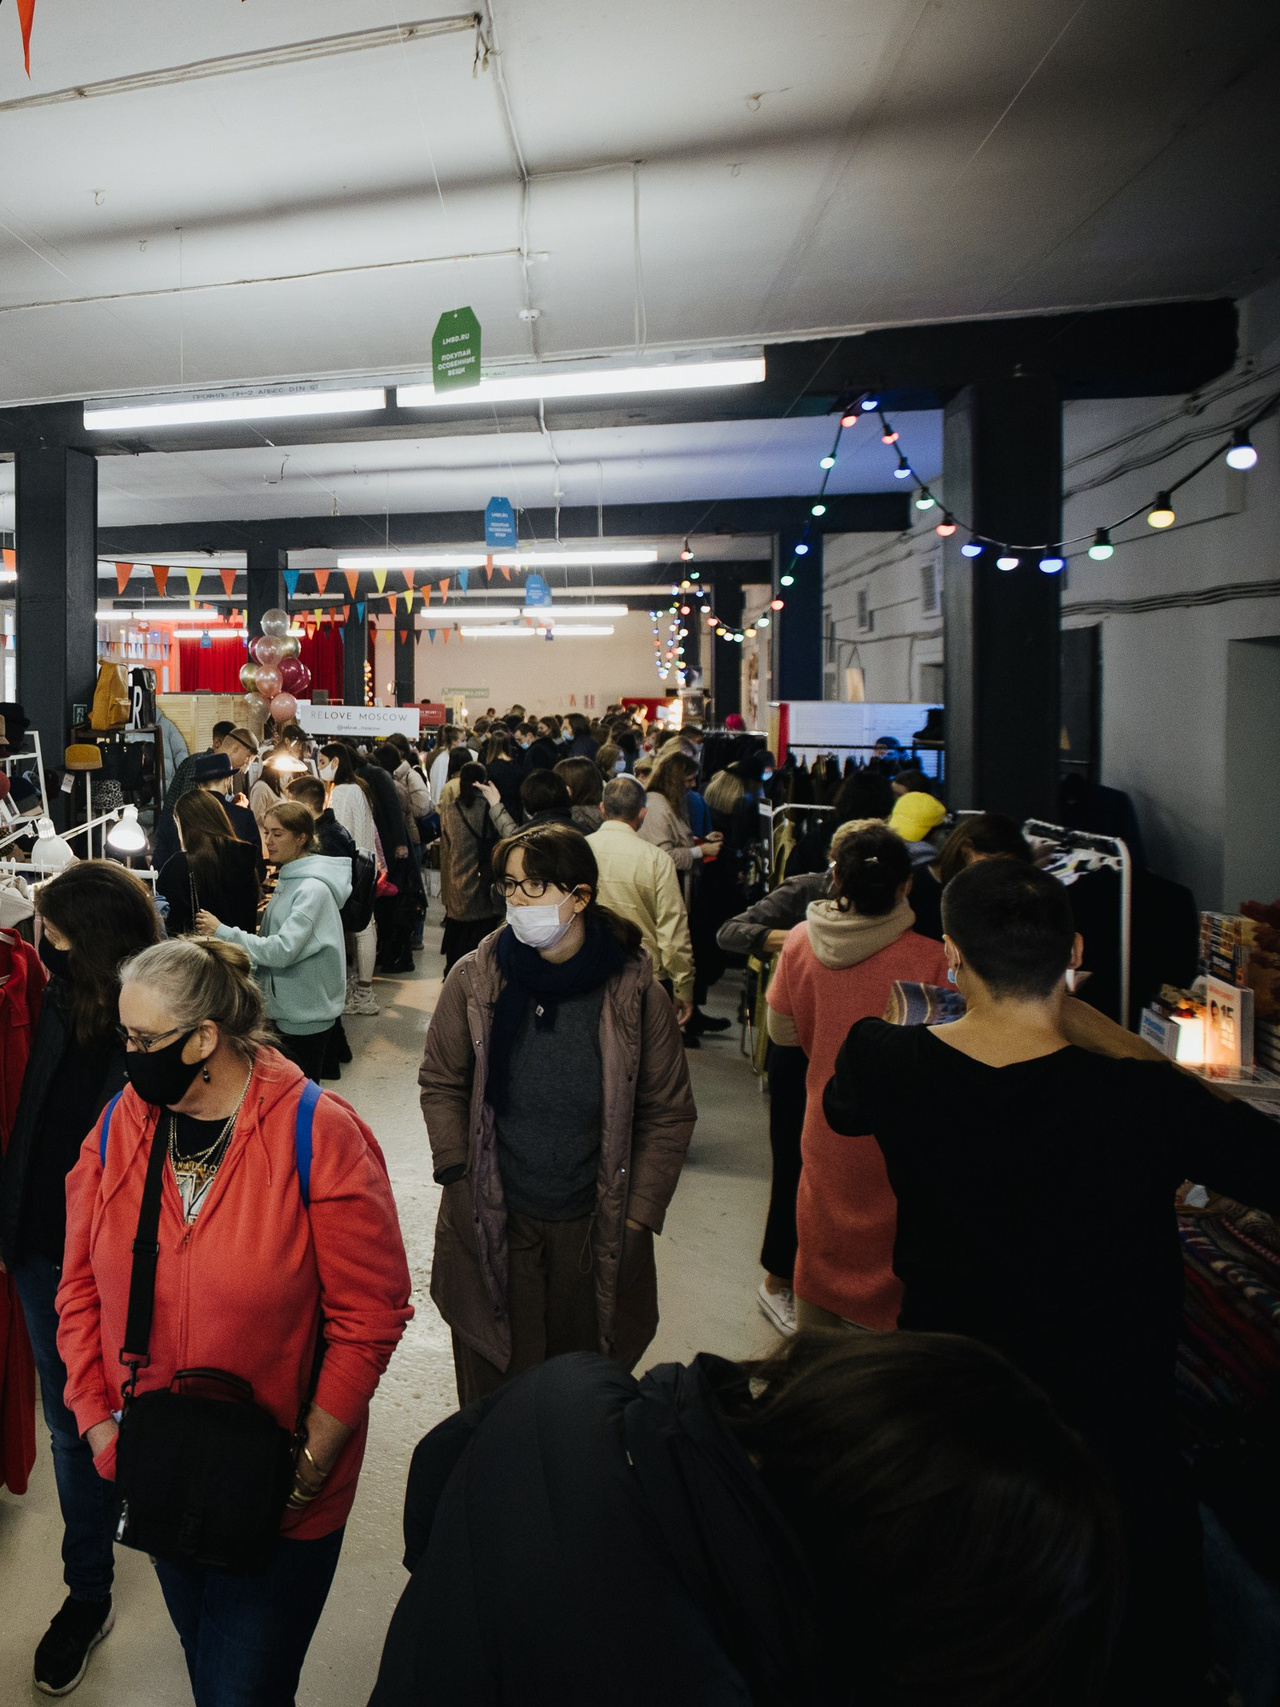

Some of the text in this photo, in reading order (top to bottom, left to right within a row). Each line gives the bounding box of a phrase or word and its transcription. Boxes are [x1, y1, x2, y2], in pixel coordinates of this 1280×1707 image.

[442, 333, 470, 345] LMBD.RU
[441, 348, 471, 361] ПОКУПАЙ
[437, 356, 475, 371] ОСОБЕННЫЕ
[448, 367, 466, 376] ВЕЩИ
[311, 710, 352, 720] RELOVE
[359, 712, 408, 721] MOSCOW
